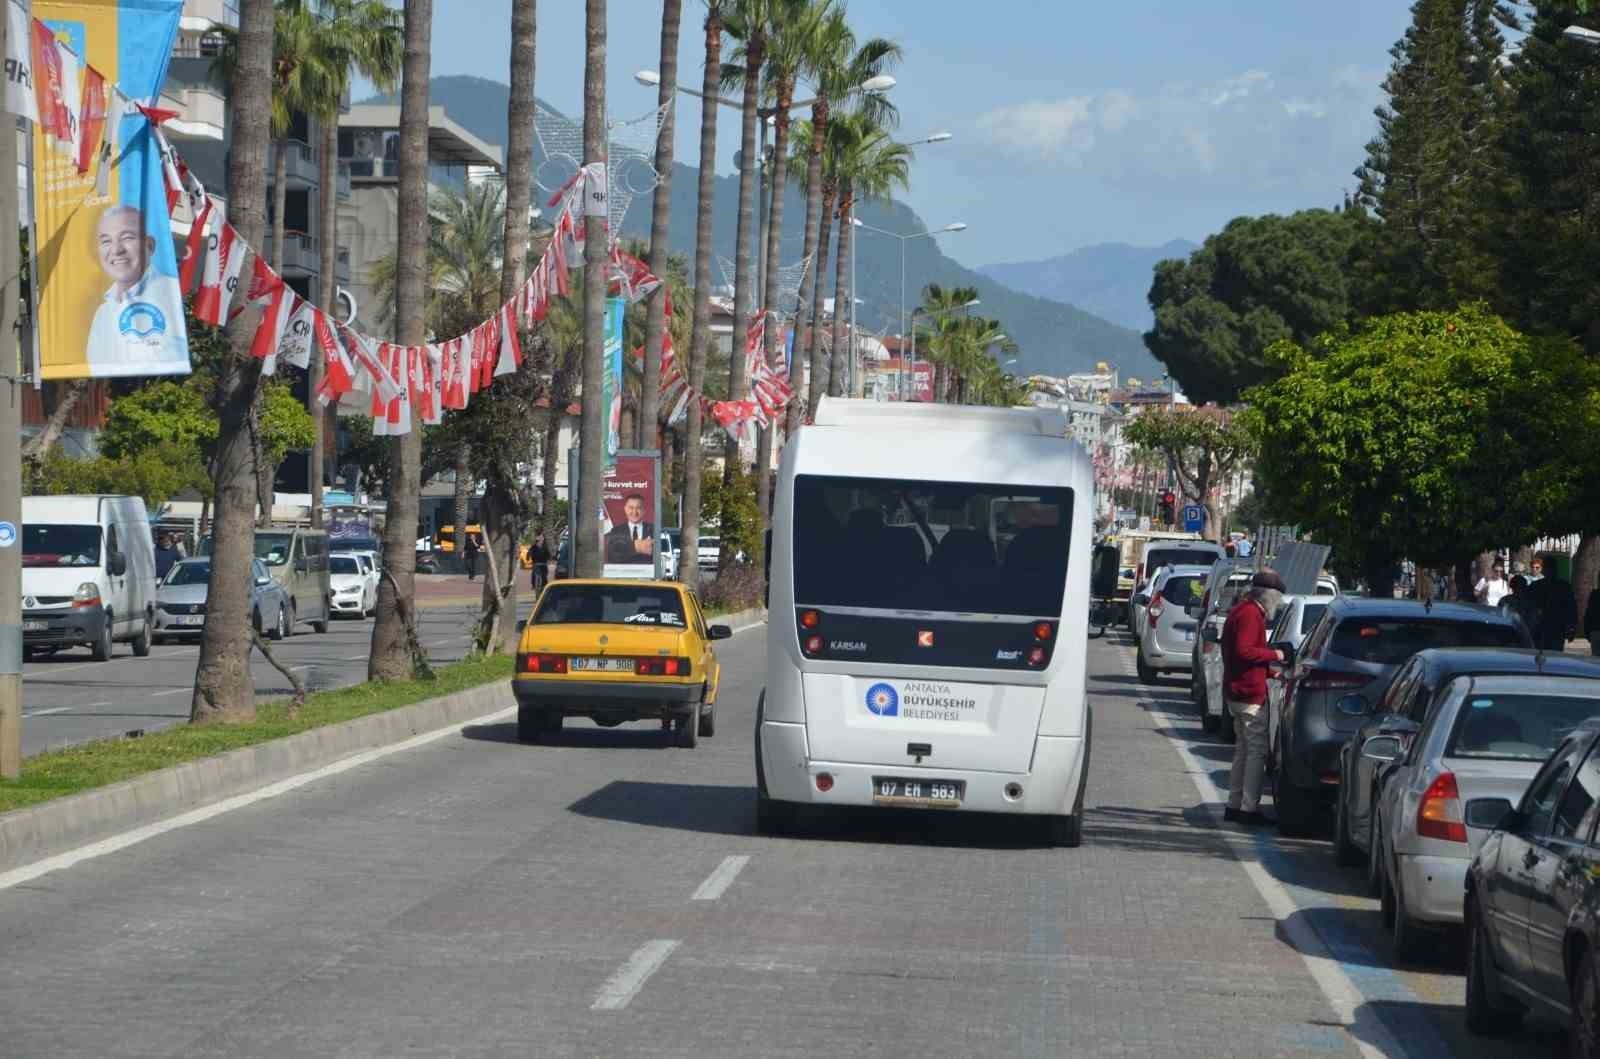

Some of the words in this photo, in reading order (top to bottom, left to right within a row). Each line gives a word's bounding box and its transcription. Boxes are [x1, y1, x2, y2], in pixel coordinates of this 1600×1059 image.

[830, 640, 867, 651] KARSAN
[904, 682, 951, 695] ANTALYA
[903, 694, 976, 710] BÜYÜKŞEHİR
[903, 708, 960, 721] BELEDİYESİ
[881, 782, 897, 796] 07
